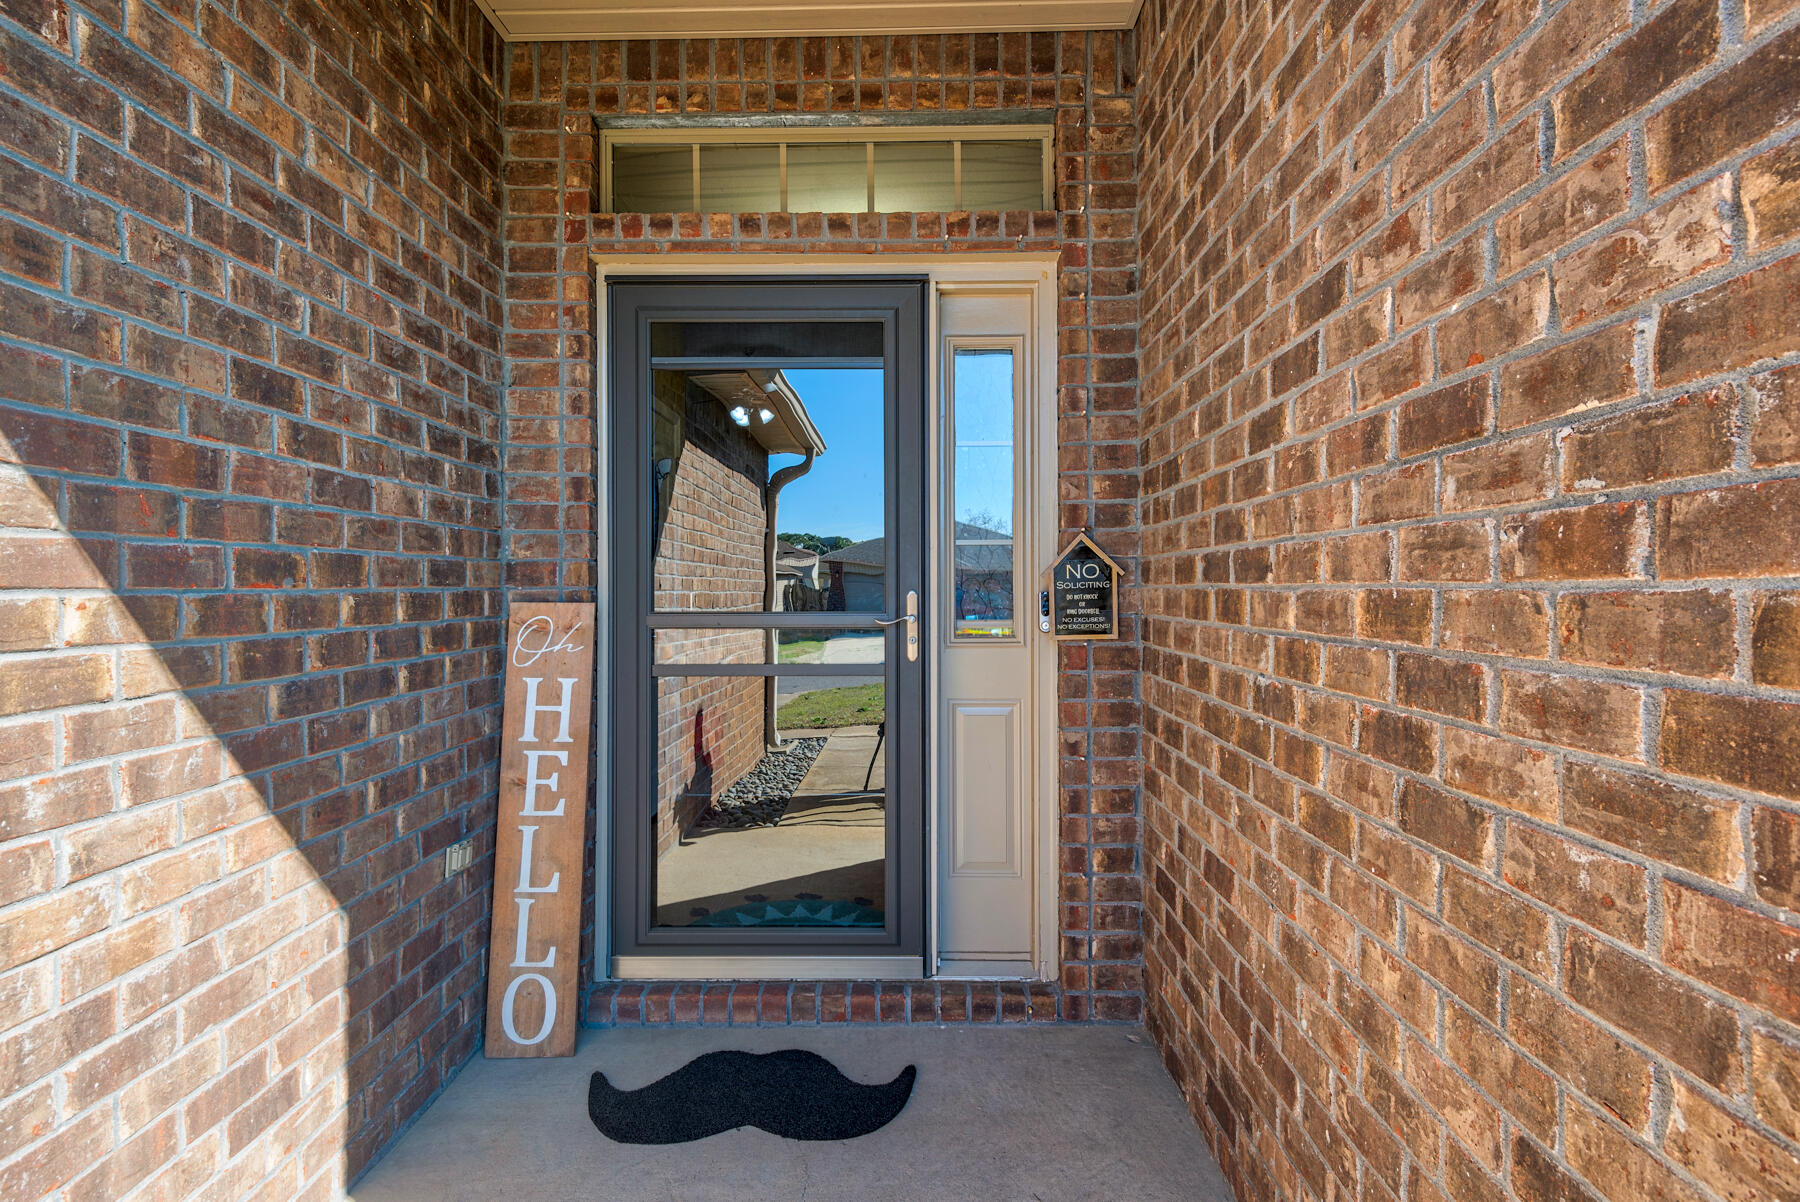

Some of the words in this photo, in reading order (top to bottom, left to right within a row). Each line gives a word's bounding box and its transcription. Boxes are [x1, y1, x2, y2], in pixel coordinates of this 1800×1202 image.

[1056, 581, 1110, 589] SOLICITING
[1066, 563, 1100, 579] NO
[512, 615, 584, 667] Oh
[501, 677, 579, 1045] HELLO
